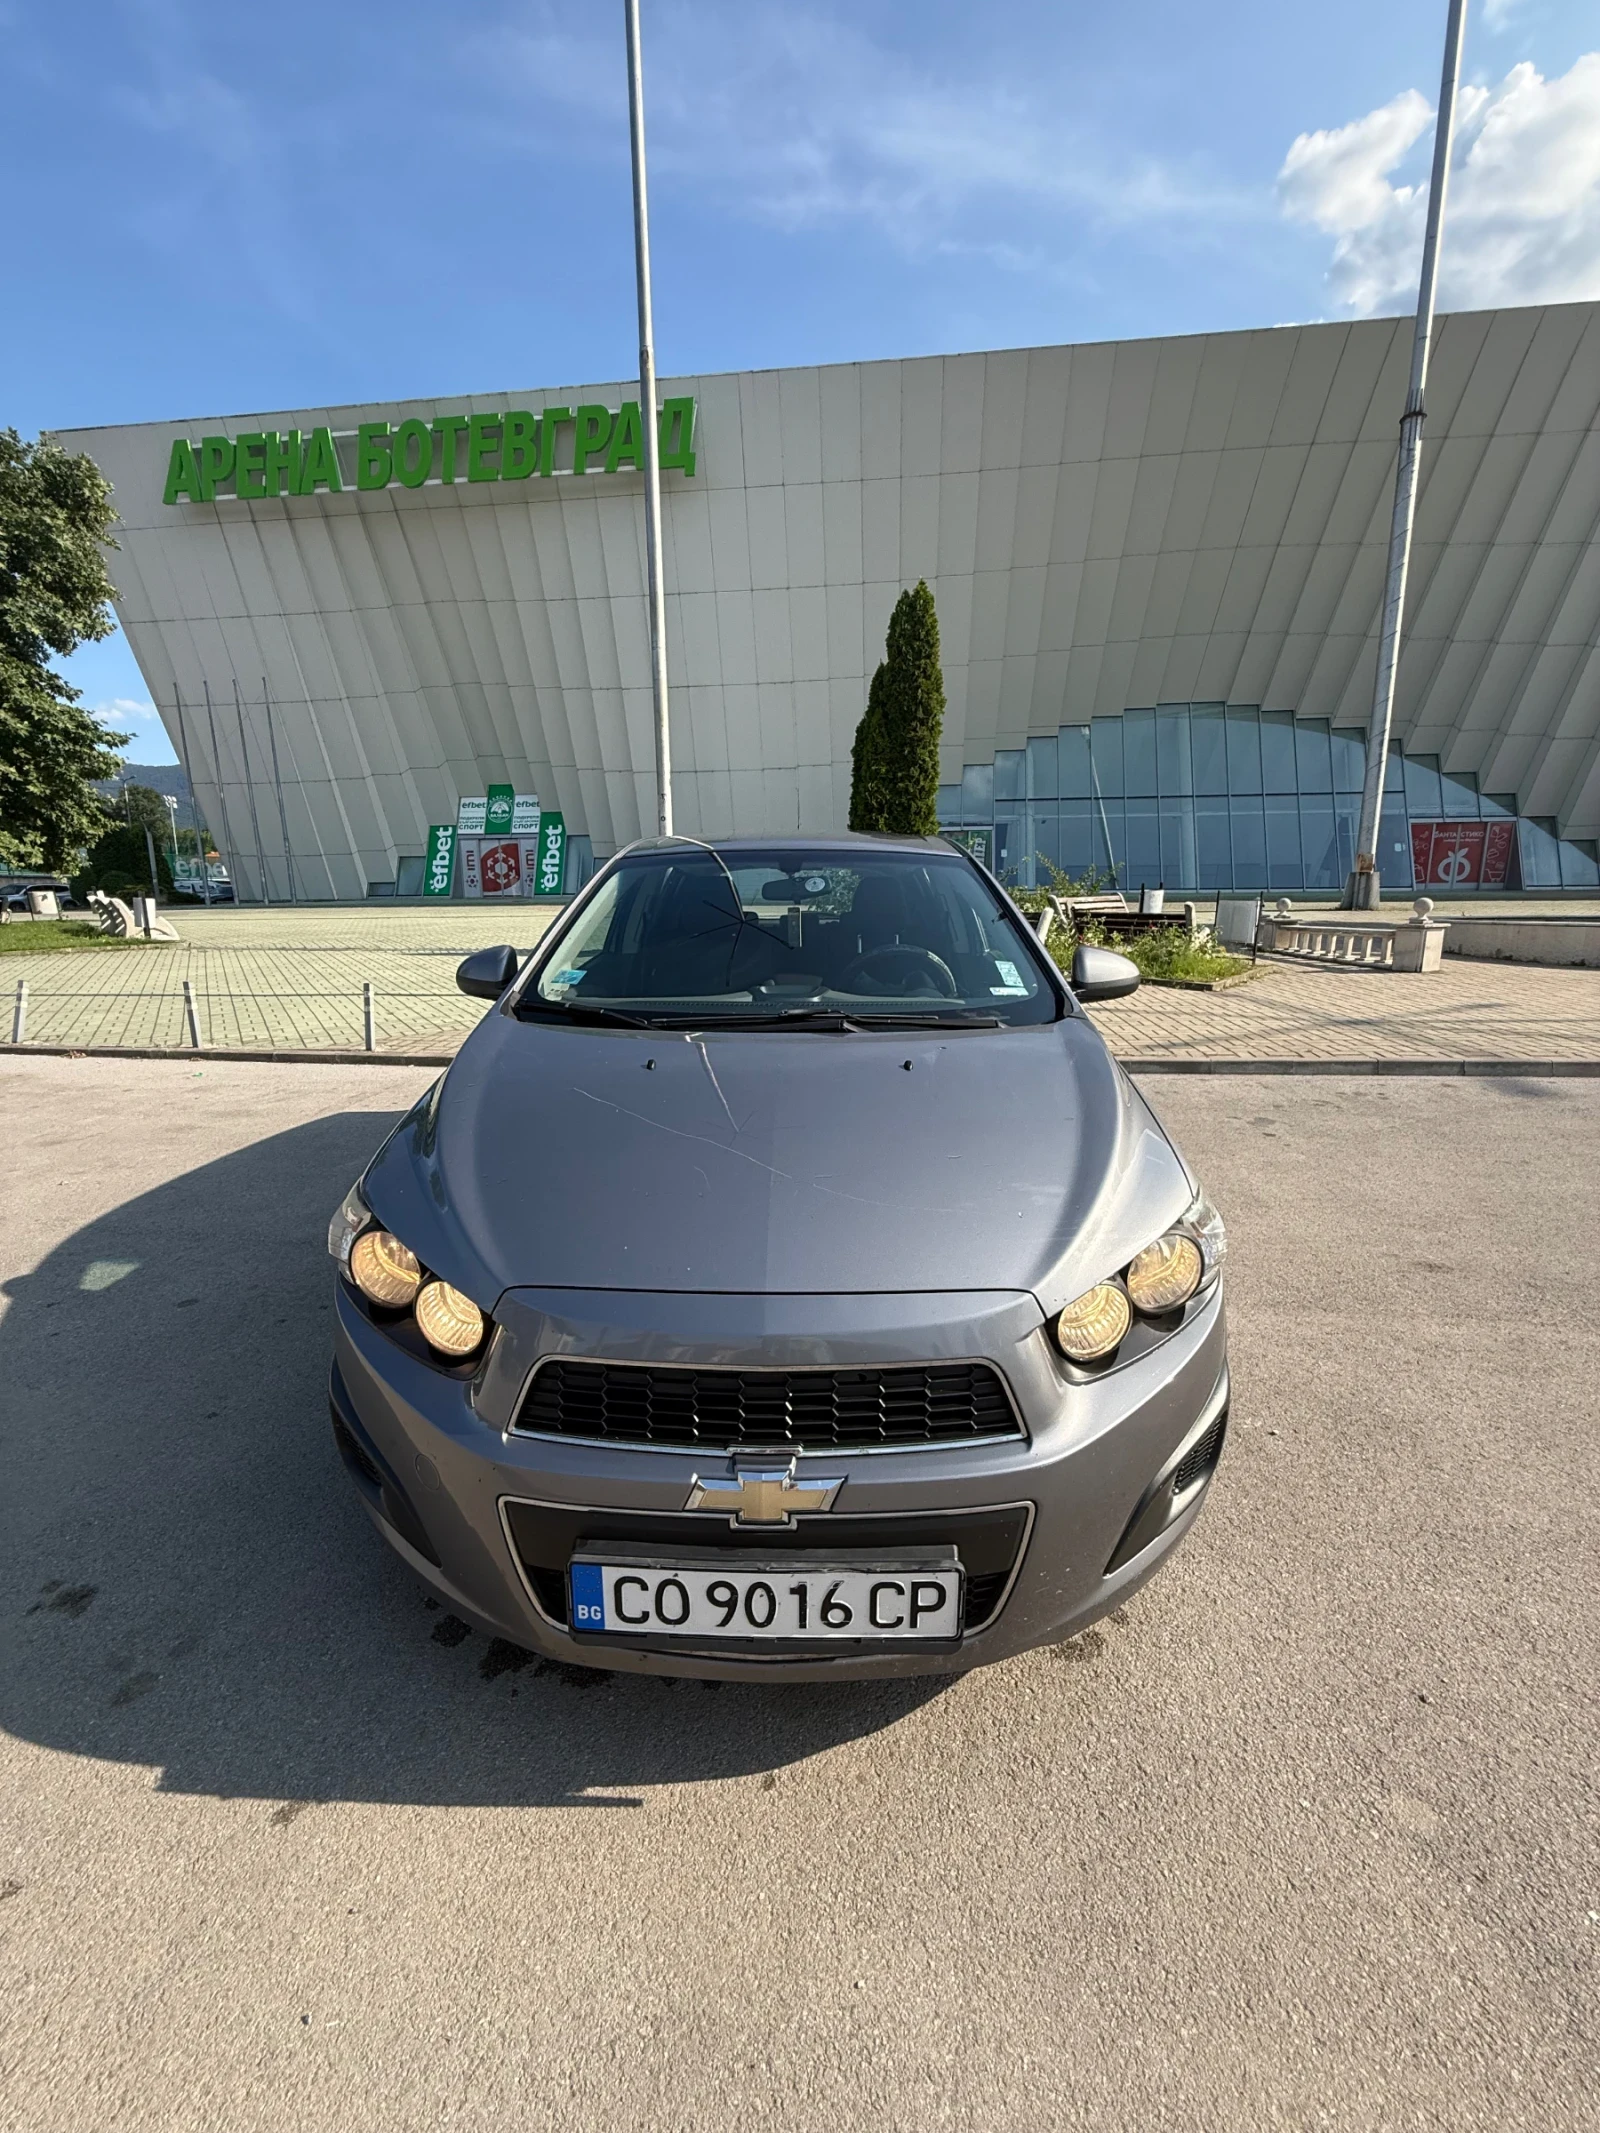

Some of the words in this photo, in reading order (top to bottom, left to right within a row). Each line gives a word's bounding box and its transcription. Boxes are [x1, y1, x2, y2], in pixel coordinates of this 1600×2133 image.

[163, 427, 342, 504] АРЕНА
[358, 397, 697, 489] БОТЕВГРАД
[462, 801, 486, 809] efbet
[516, 800, 540, 808] efbet
[613, 1574, 691, 1626] CO
[706, 1580, 853, 1629] 9016
[869, 1580, 947, 1630] CP
[577, 1604, 602, 1620] BG
